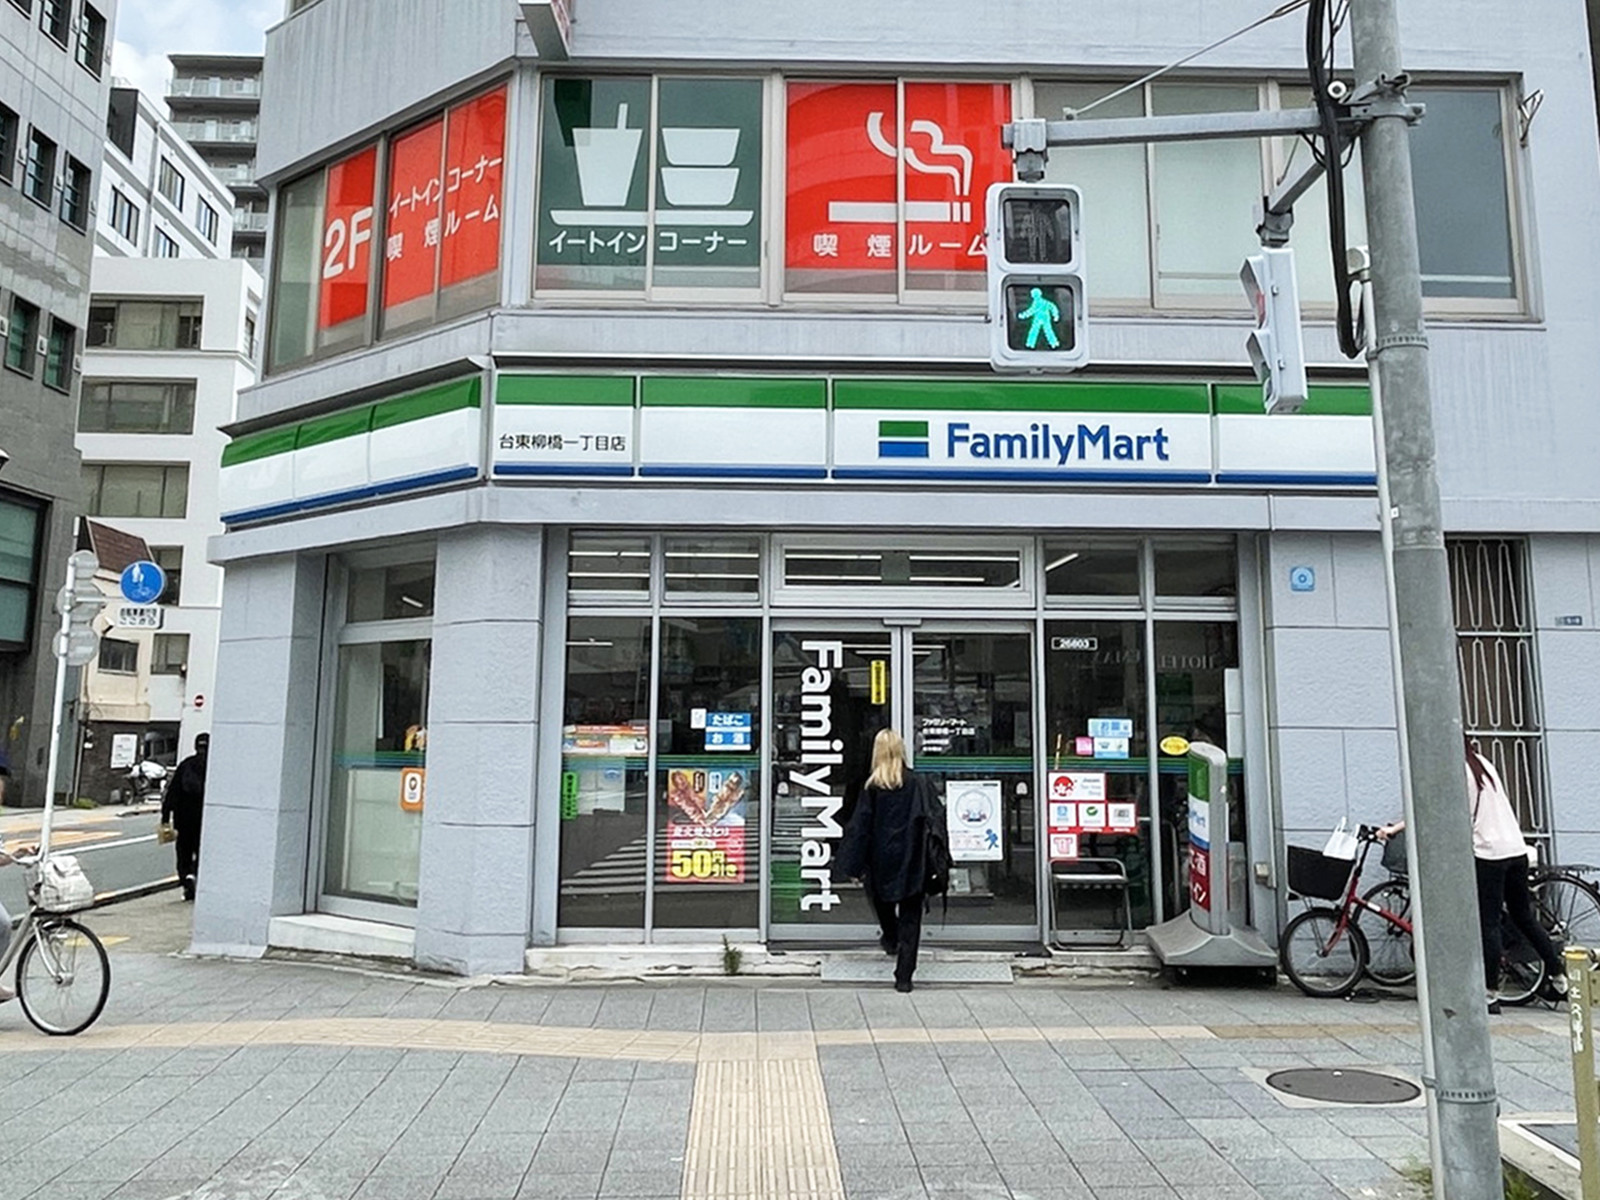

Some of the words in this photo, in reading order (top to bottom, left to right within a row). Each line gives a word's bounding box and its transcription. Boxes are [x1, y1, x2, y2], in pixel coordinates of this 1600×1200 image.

[322, 206, 373, 280] 2F
[498, 433, 627, 452] 台東柳橋一丁目店
[947, 422, 1169, 466] FamilyMart
[788, 640, 844, 912] FamilyMart
